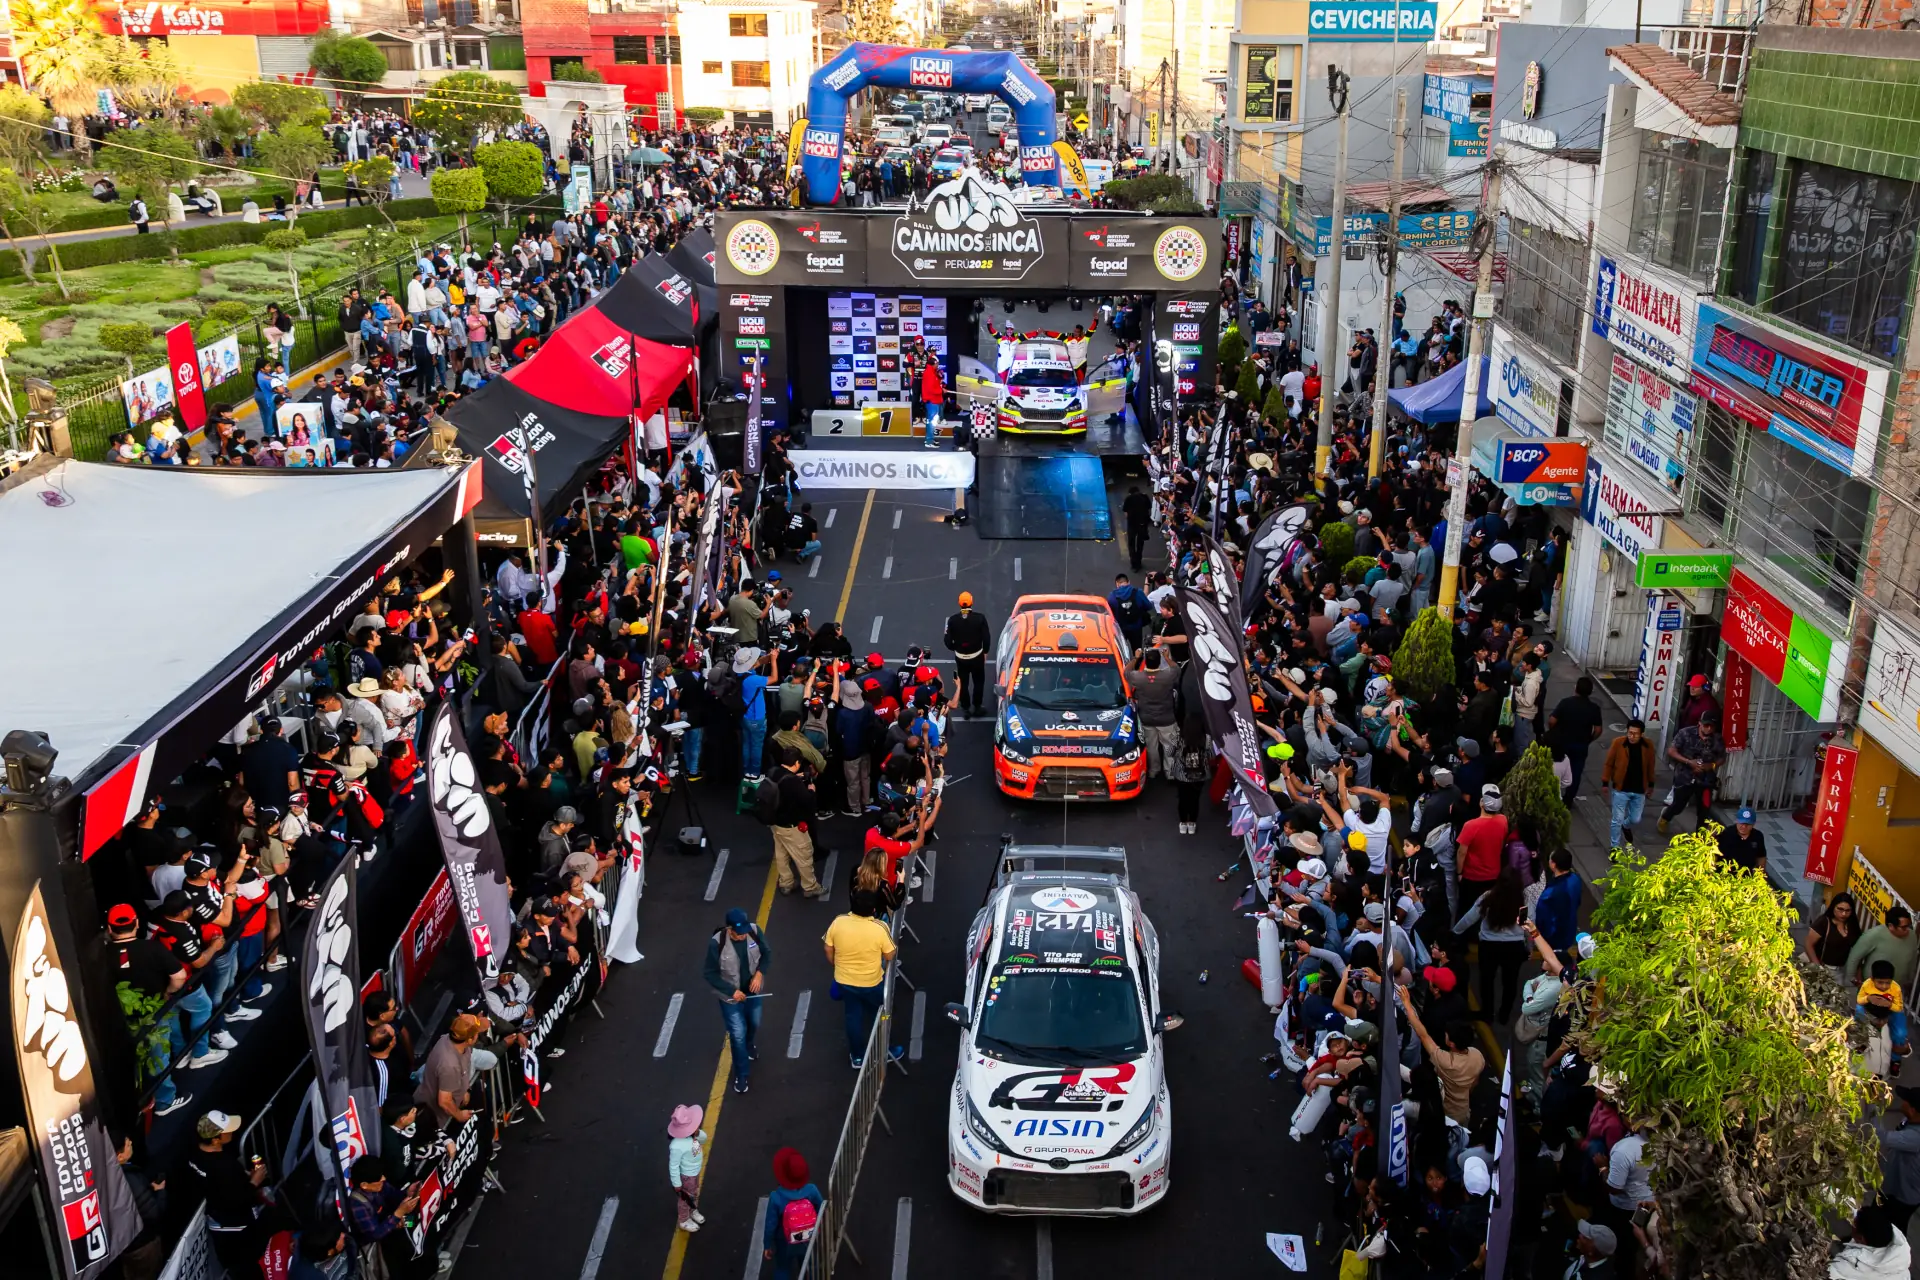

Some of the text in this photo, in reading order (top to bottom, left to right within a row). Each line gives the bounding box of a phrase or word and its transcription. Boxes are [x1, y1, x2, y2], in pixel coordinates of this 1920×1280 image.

[161, 4, 225, 29] Katya
[1310, 9, 1434, 30] CEVICHERIA
[912, 58, 951, 74] LIQUI
[911, 72, 951, 87] MOLY
[805, 130, 839, 147] LIQUI
[804, 142, 838, 158] MOLY
[1021, 146, 1054, 159] LIQUI
[1021, 158, 1055, 172] MOLY
[1343, 217, 1374, 231] EBA
[1229, 225, 1238, 260] TORTAS
[806, 253, 844, 269] fepad
[1090, 257, 1128, 272] fepad
[1617, 271, 1681, 336] FARMACIA
[740, 317, 764, 326] LIQUI
[740, 325, 764, 334] MOLY
[1175, 324, 1198, 332] LIQUI
[1174, 331, 1199, 340] MOLY
[177, 381, 198, 398] TOYOTA
[829, 418, 844, 435] 2
[879, 410, 893, 433] 1
[1512, 449, 1539, 463] BCP
[1629, 436, 1660, 470] MILAGRO
[1542, 466, 1579, 479] Agente
[1600, 474, 1653, 538] FARMACIA
[1597, 511, 1645, 561] MILAGR
[1669, 563, 1719, 574] Interbank
[278, 615, 331, 669] TOYOTA
[332, 576, 375, 620] GAZOO
[375, 544, 411, 581] Racing
[1727, 598, 1785, 655] FARMACIA
[1740, 622, 1764, 646] CENTRAL
[1649, 601, 1679, 722] FRMACIA
[1007, 714, 1027, 739] VOLT
[1118, 714, 1134, 738] VOLT
[1041, 745, 1082, 754] ROMERO
[1815, 753, 1847, 873] FARMACIA
[1806, 872, 1833, 885] CENTRAL
[1863, 872, 1879, 894] NO
[1853, 884, 1880, 920] GARAJE
[1038, 913, 1092, 932] 712
[1003, 955, 1036, 964] Arona
[1090, 957, 1122, 967] Arona
[1092, 969, 1123, 977] Racing
[1014, 1119, 1105, 1138] AISIN
[60, 1119, 87, 1194] GAZOO
[70, 1112, 96, 1188] Racing
[965, 1138, 983, 1161] Valvoline
[1034, 1146, 1095, 1155] GRUPOPANA
[46, 1116, 74, 1202] TOYOTA
[80, 1195, 107, 1261] GR
